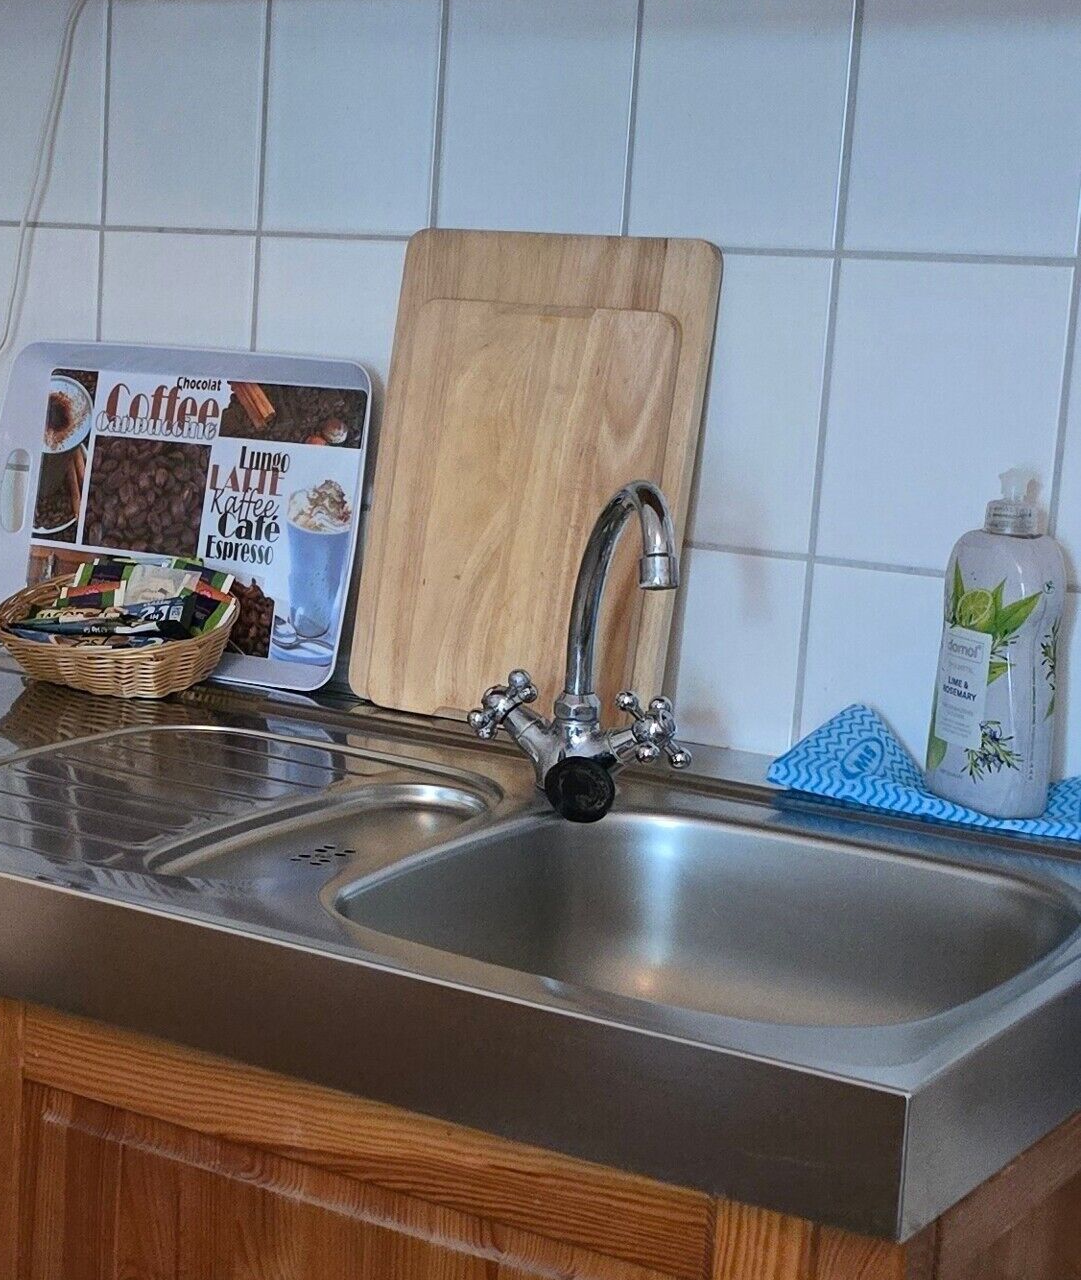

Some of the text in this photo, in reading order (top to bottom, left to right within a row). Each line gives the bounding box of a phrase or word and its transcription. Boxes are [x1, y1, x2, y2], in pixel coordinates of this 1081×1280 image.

[176, 376, 222, 392] Chocolat
[105, 383, 220, 430] Coffee
[239, 445, 290, 474] Lungo
[209, 465, 285, 497] LATTE
[210, 486, 281, 524] Kaffee
[217, 511, 281, 543] Café
[204, 534, 274, 566] Espresso
[942, 683, 977, 702] ROSEMARY
[947, 675, 969, 690] LIME &
